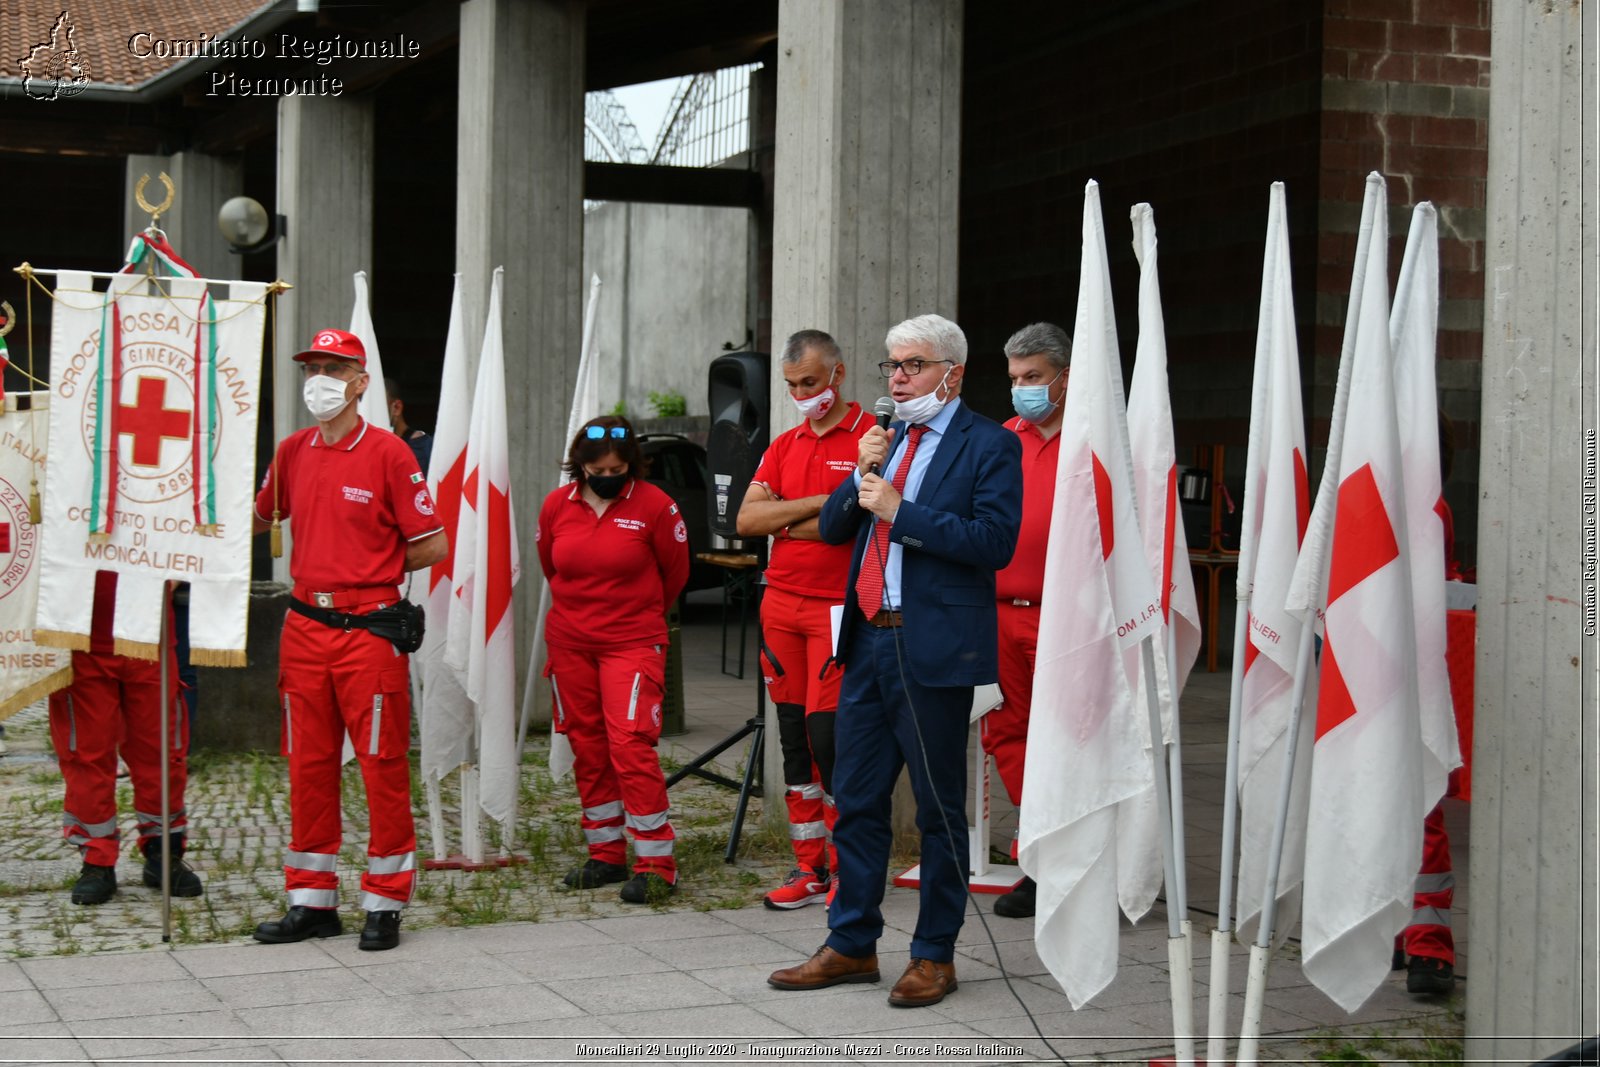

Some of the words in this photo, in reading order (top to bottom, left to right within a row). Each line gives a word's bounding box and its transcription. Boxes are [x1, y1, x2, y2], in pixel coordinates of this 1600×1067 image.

[121, 311, 180, 336] OSSA
[12, 503, 34, 559] AGOSTO
[133, 531, 147, 547] DI
[84, 542, 204, 575] MONCALIERI
[3, 561, 26, 587] 1864
